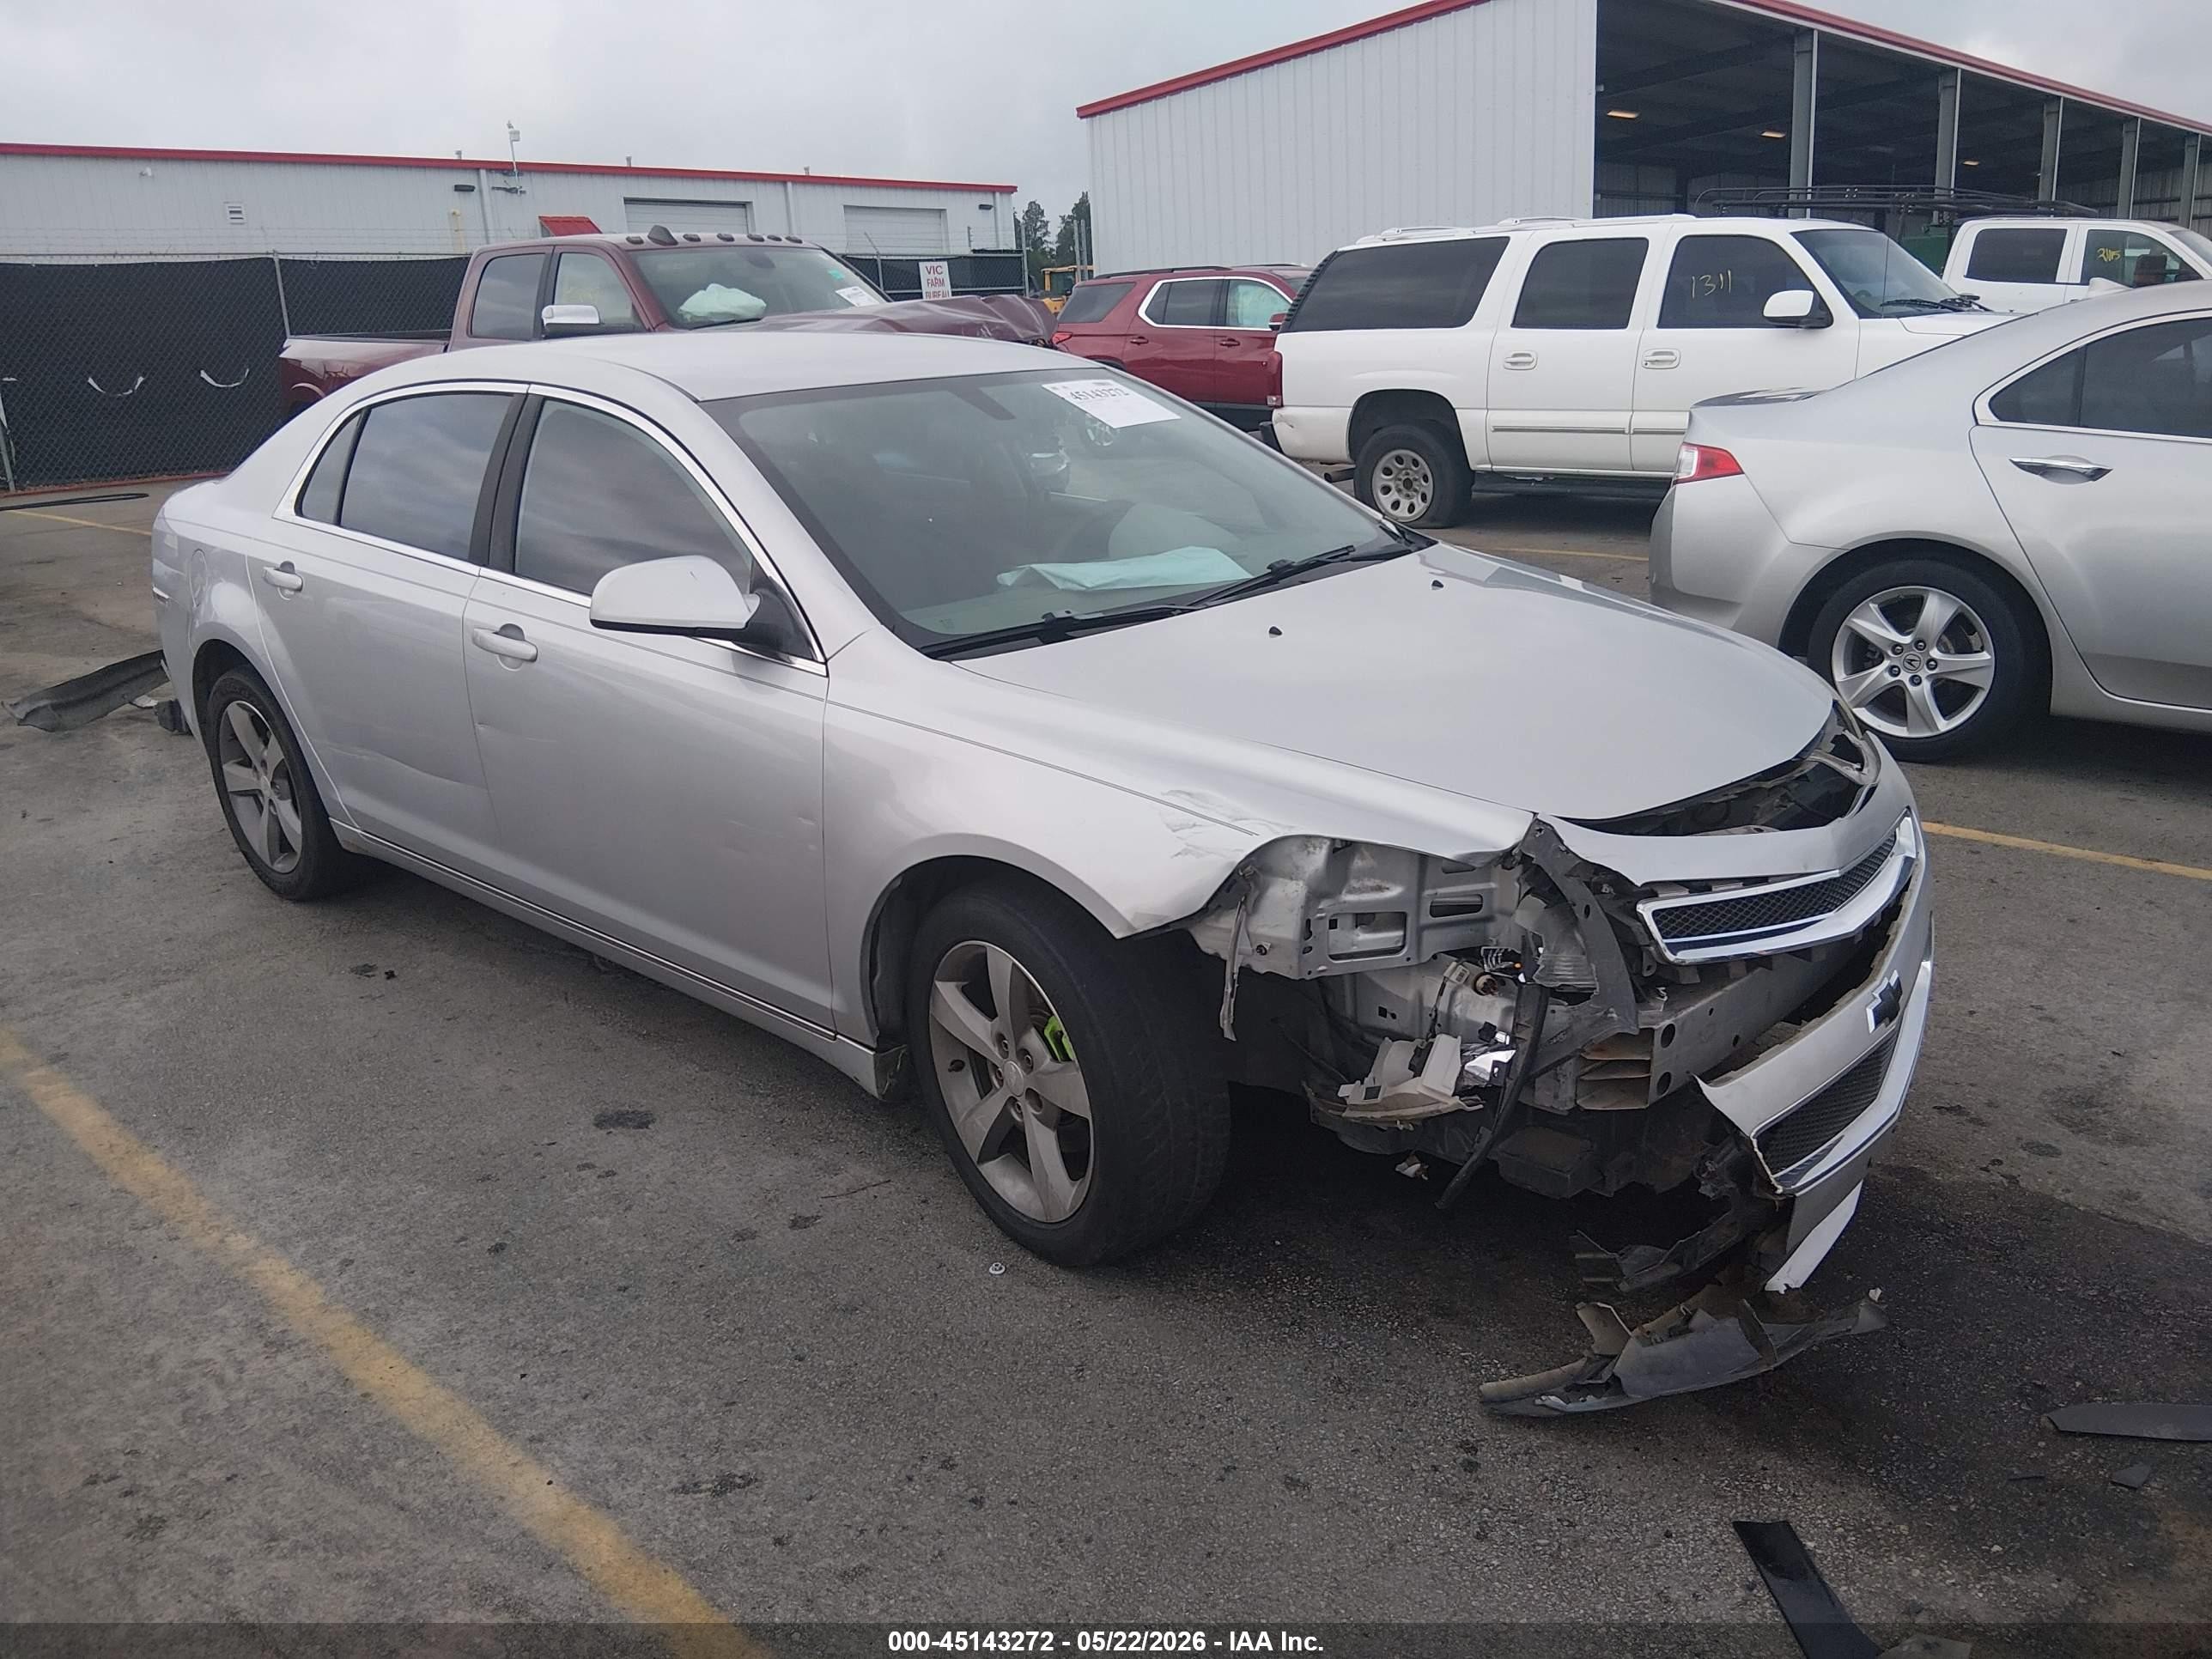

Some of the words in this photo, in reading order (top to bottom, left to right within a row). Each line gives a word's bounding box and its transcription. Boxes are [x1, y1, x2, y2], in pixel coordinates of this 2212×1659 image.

[925, 265, 944, 275] VIC
[927, 276, 945, 288] FARM
[1692, 269, 1731, 299] 1311
